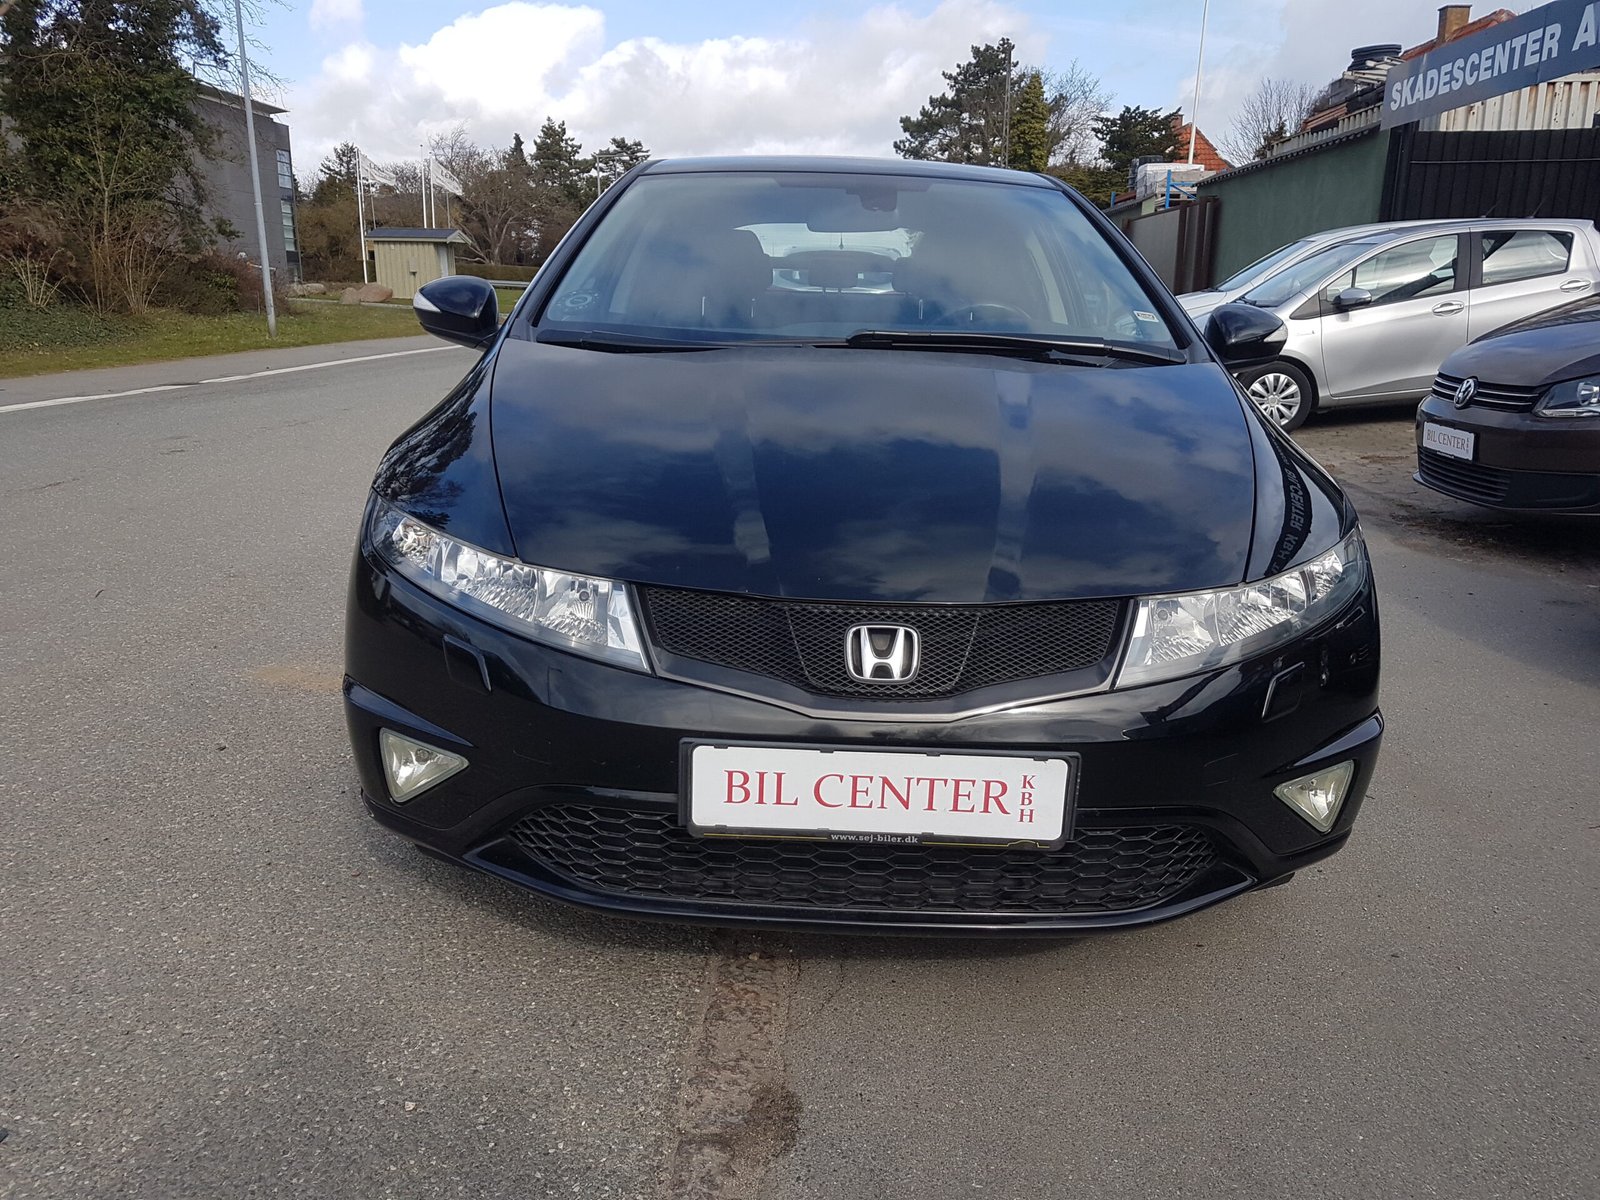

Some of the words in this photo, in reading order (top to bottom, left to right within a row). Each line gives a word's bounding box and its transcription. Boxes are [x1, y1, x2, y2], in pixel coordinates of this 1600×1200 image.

[1390, 23, 1562, 111] SKADESCENTER
[1427, 429, 1437, 443] BIL
[1438, 432, 1466, 451] CENTER
[723, 769, 799, 806] BIL
[813, 773, 1011, 816] CENTER
[1018, 774, 1036, 823] KBH
[831, 834, 918, 843] www.sej-biler.dk
